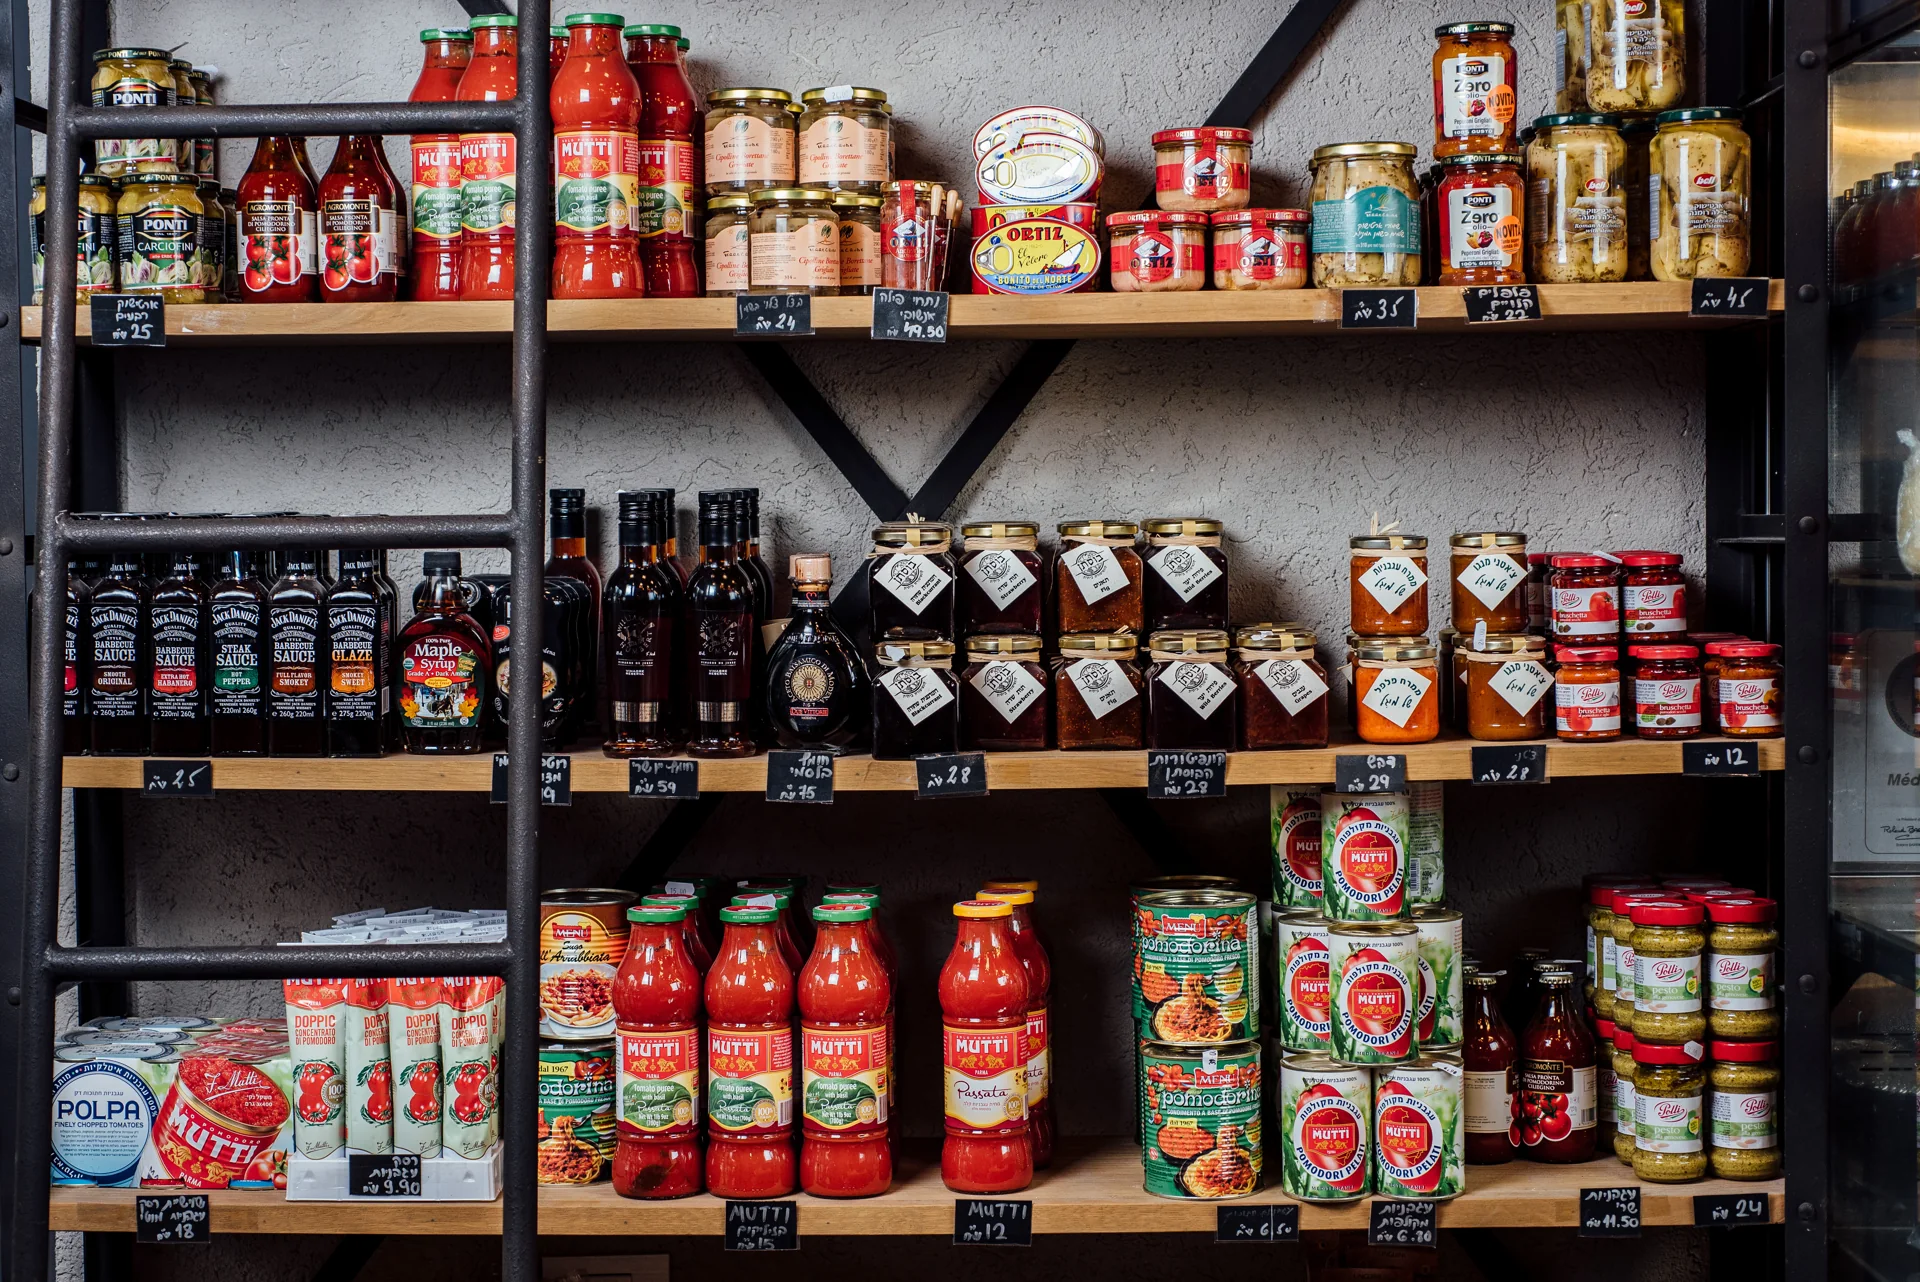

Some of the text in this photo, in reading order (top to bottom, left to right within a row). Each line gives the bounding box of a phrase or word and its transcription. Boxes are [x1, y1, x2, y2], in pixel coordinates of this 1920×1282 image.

[1454, 79, 1491, 93] Zero
[112, 93, 156, 104] PONTI
[461, 143, 507, 159] MUTTI
[561, 141, 613, 157] MUTTI
[249, 204, 291, 212] AGROMONTE
[327, 203, 369, 211] AGROMONTE
[1461, 211, 1499, 224] Zero
[143, 219, 187, 231] PONTI
[1472, 223, 1487, 231] olio
[1007, 227, 1064, 241] ORTIZ
[137, 242, 193, 251] CARCIOFINI
[1017, 248, 1026, 258] El
[1018, 253, 1048, 268] Velero
[998, 274, 1072, 285] BONITO NORTE
[1727, 286, 1753, 308] 45
[1377, 296, 1404, 319] 35
[1505, 309, 1529, 320] 22
[775, 313, 795, 330] 24
[131, 324, 153, 339] 25
[903, 321, 944, 338] 49.50
[1000, 577, 1027, 601] Strawberry
[1100, 585, 1111, 593] Fig
[1183, 569, 1213, 595] Wild Berries
[915, 578, 942, 606] Blackcurrant
[91, 610, 138, 628] JACK DANIEL'S
[1638, 608, 1672, 617] bruschetta
[152, 611, 199, 629] JACK DANIEL'S
[95, 640, 134, 649] BARBECUE
[155, 646, 195, 655] BARBECUE
[221, 645, 251, 653] STEAK
[274, 642, 314, 650] BARBECUE
[414, 643, 462, 660] Maple
[94, 649, 136, 662] SAUCE
[155, 654, 195, 666] SAUCE
[216, 654, 258, 666] SAUCE
[332, 650, 373, 662] GLAZE
[420, 659, 456, 671] Syrup
[97, 677, 133, 685] ORIGINAL
[157, 679, 193, 687] HABANERO
[279, 679, 309, 687] SMOKEY
[1294, 689, 1313, 704] Grapes
[1726, 748, 1748, 765] 12
[172, 765, 208, 789] 25
[947, 765, 971, 784] 28
[1506, 765, 1530, 780] 28
[657, 780, 676, 793] 59
[1184, 780, 1208, 794] 28
[1369, 774, 1389, 790] 29
[799, 784, 817, 800] 75
[1351, 853, 1388, 863] MUTTI
[1335, 867, 1404, 902] POMODORI PELATI
[562, 941, 583, 951] Sugo
[1142, 937, 1241, 953] pomodorina
[1345, 964, 1408, 986] עגבניות מקולפות
[1652, 986, 1678, 994] pesto
[1716, 983, 1741, 991] pesto
[1358, 993, 1395, 1005] MUTTI
[451, 1014, 488, 1030] DOPPIO
[1342, 1009, 1412, 1045] POMODORI PELATI
[295, 1028, 336, 1036] CONCENTRATO
[302, 1037, 336, 1045] POMODORO
[712, 1040, 759, 1055] MUTTI
[811, 1040, 862, 1055] MUTTI
[956, 1039, 1008, 1053] MUTTI
[628, 1042, 679, 1057] MUTTI
[954, 1080, 1012, 1099] Passata
[57, 1100, 140, 1120] POLPA
[54, 1121, 144, 1129] FINELY CHOPPED TOMATOES
[1654, 1127, 1680, 1135] pesto
[168, 1107, 261, 1164] MUTTI
[384, 1179, 420, 1195] 9.90
[729, 1205, 790, 1224] MUTTI
[968, 1201, 1027, 1219] MUTTI
[1736, 1199, 1762, 1217] 24
[1603, 1214, 1639, 1228] 11.50
[174, 1223, 194, 1238] 18
[986, 1223, 1008, 1240] 12
[758, 1237, 775, 1250] 15
